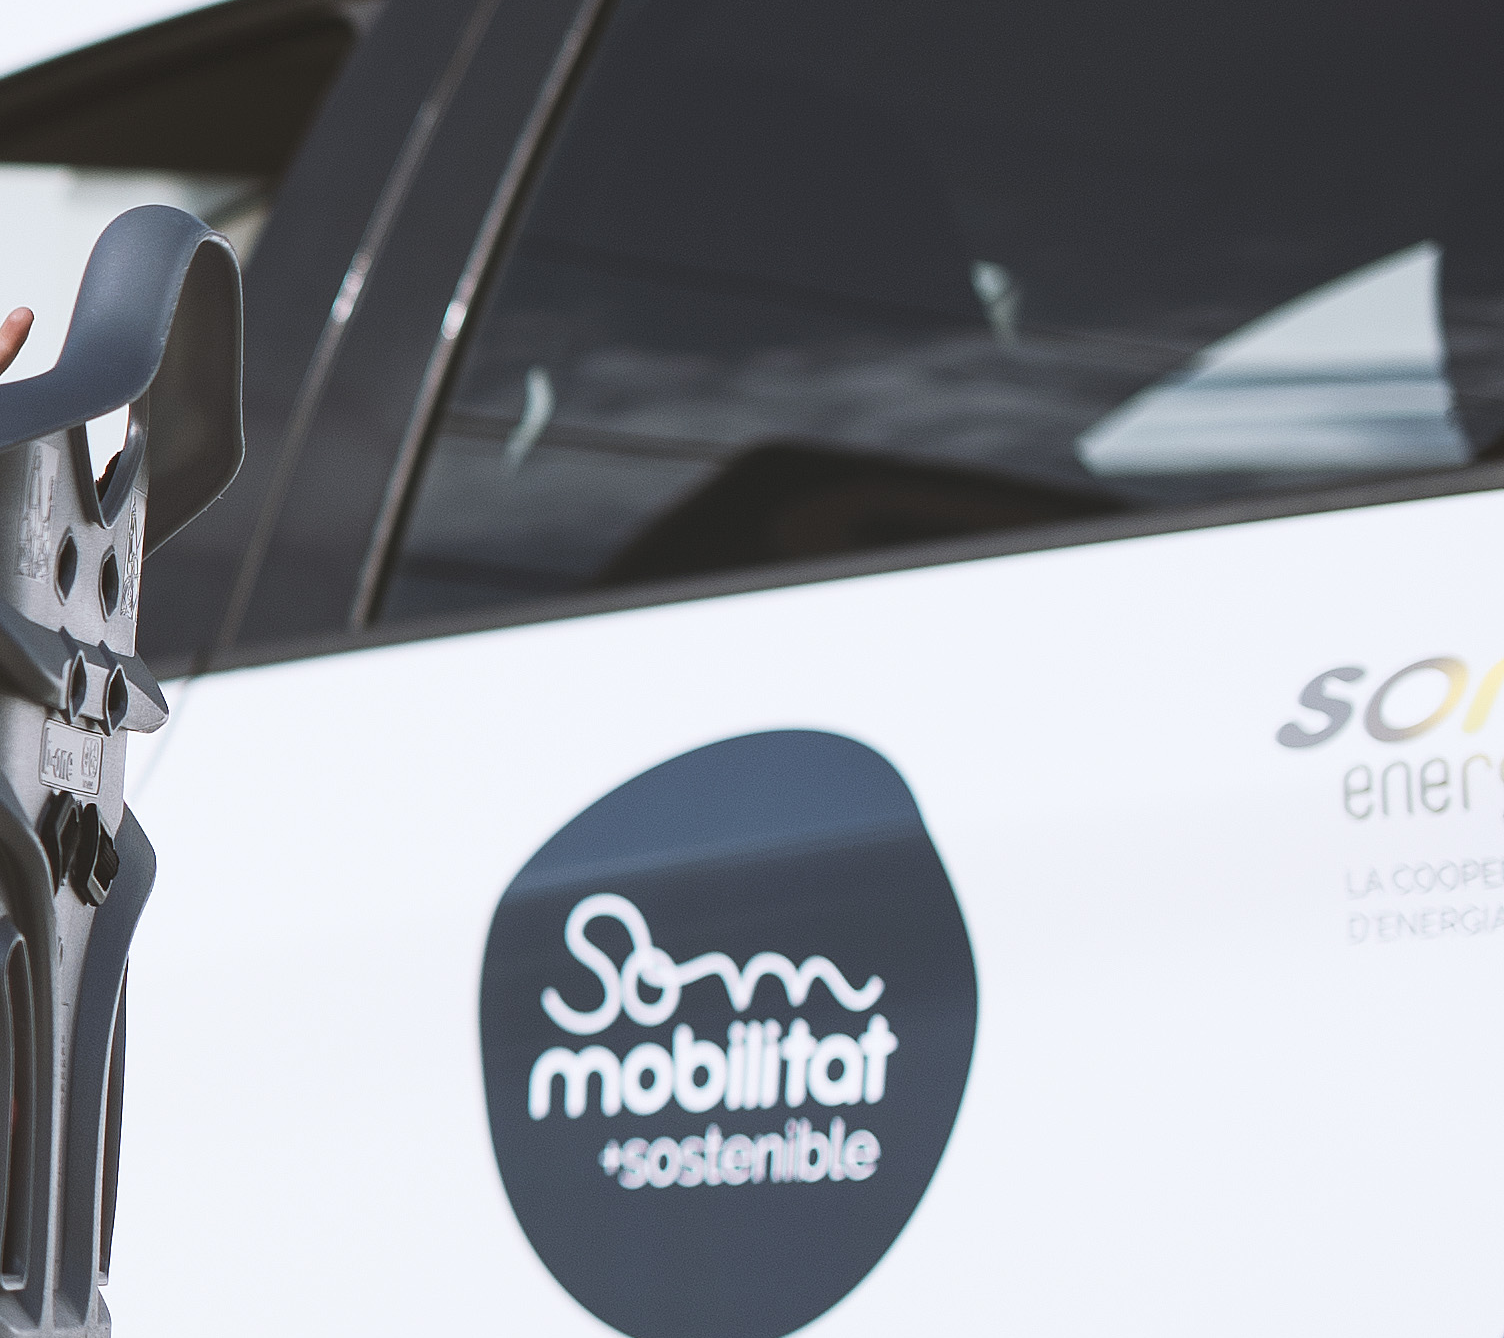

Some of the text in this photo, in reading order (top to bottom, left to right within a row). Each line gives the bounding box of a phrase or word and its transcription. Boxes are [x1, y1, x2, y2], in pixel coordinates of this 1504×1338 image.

[1343, 752, 1504, 823] ener
[1391, 857, 1504, 896] COOPE
[541, 892, 885, 1036] Som
[528, 1014, 898, 1121] mobilitat
